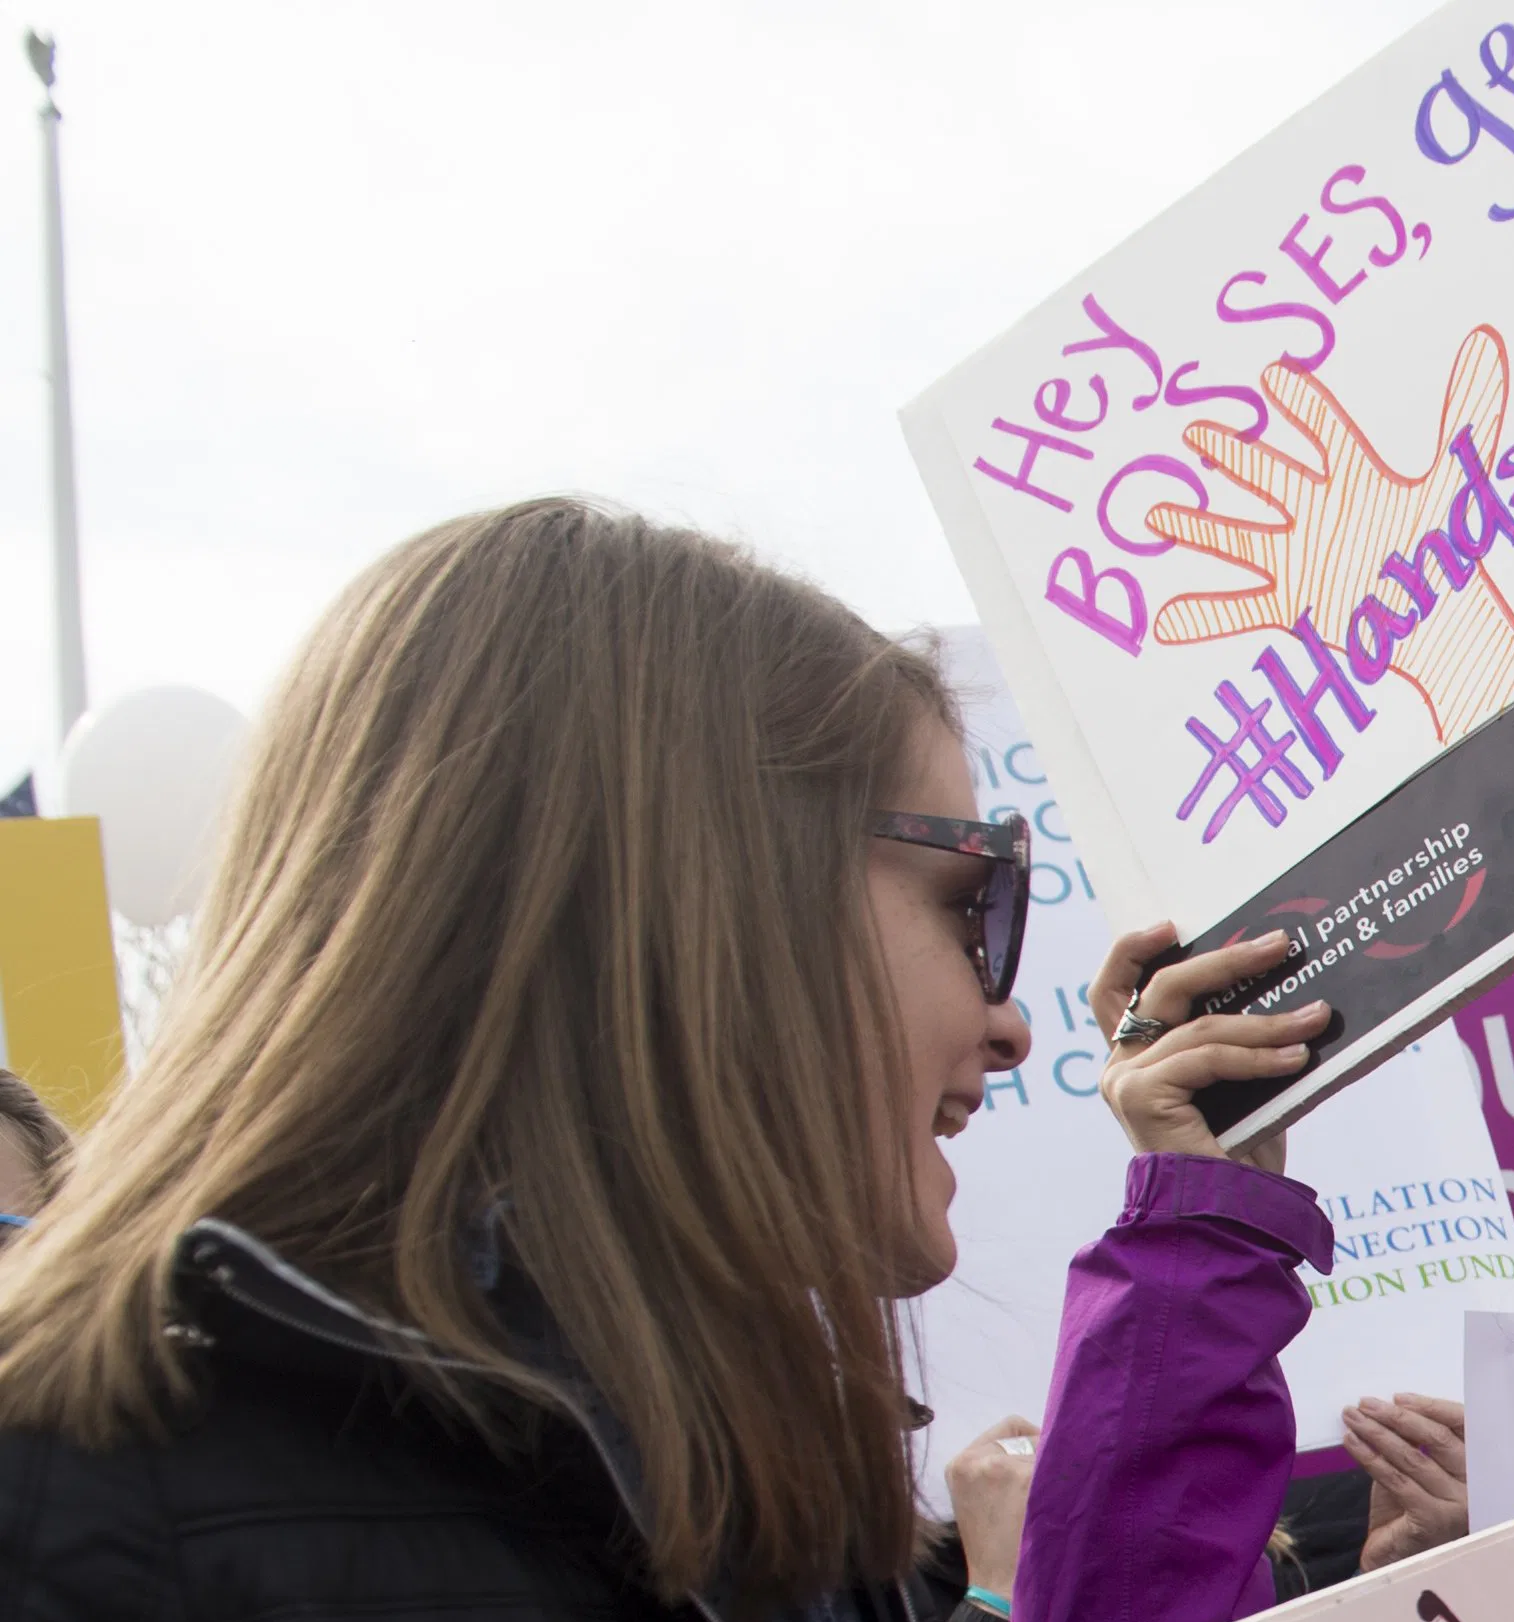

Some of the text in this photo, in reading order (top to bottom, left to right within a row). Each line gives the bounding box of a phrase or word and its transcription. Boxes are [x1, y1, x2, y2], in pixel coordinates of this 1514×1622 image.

[973, 294, 1162, 513] Hey
[1045, 165, 1432, 658] BOSSES,
[1257, 846, 1483, 1010] women & families
[1316, 822, 1470, 943] partnership
[1306, 1268, 1406, 1310] TION
[1332, 1214, 1509, 1265] NECTION
